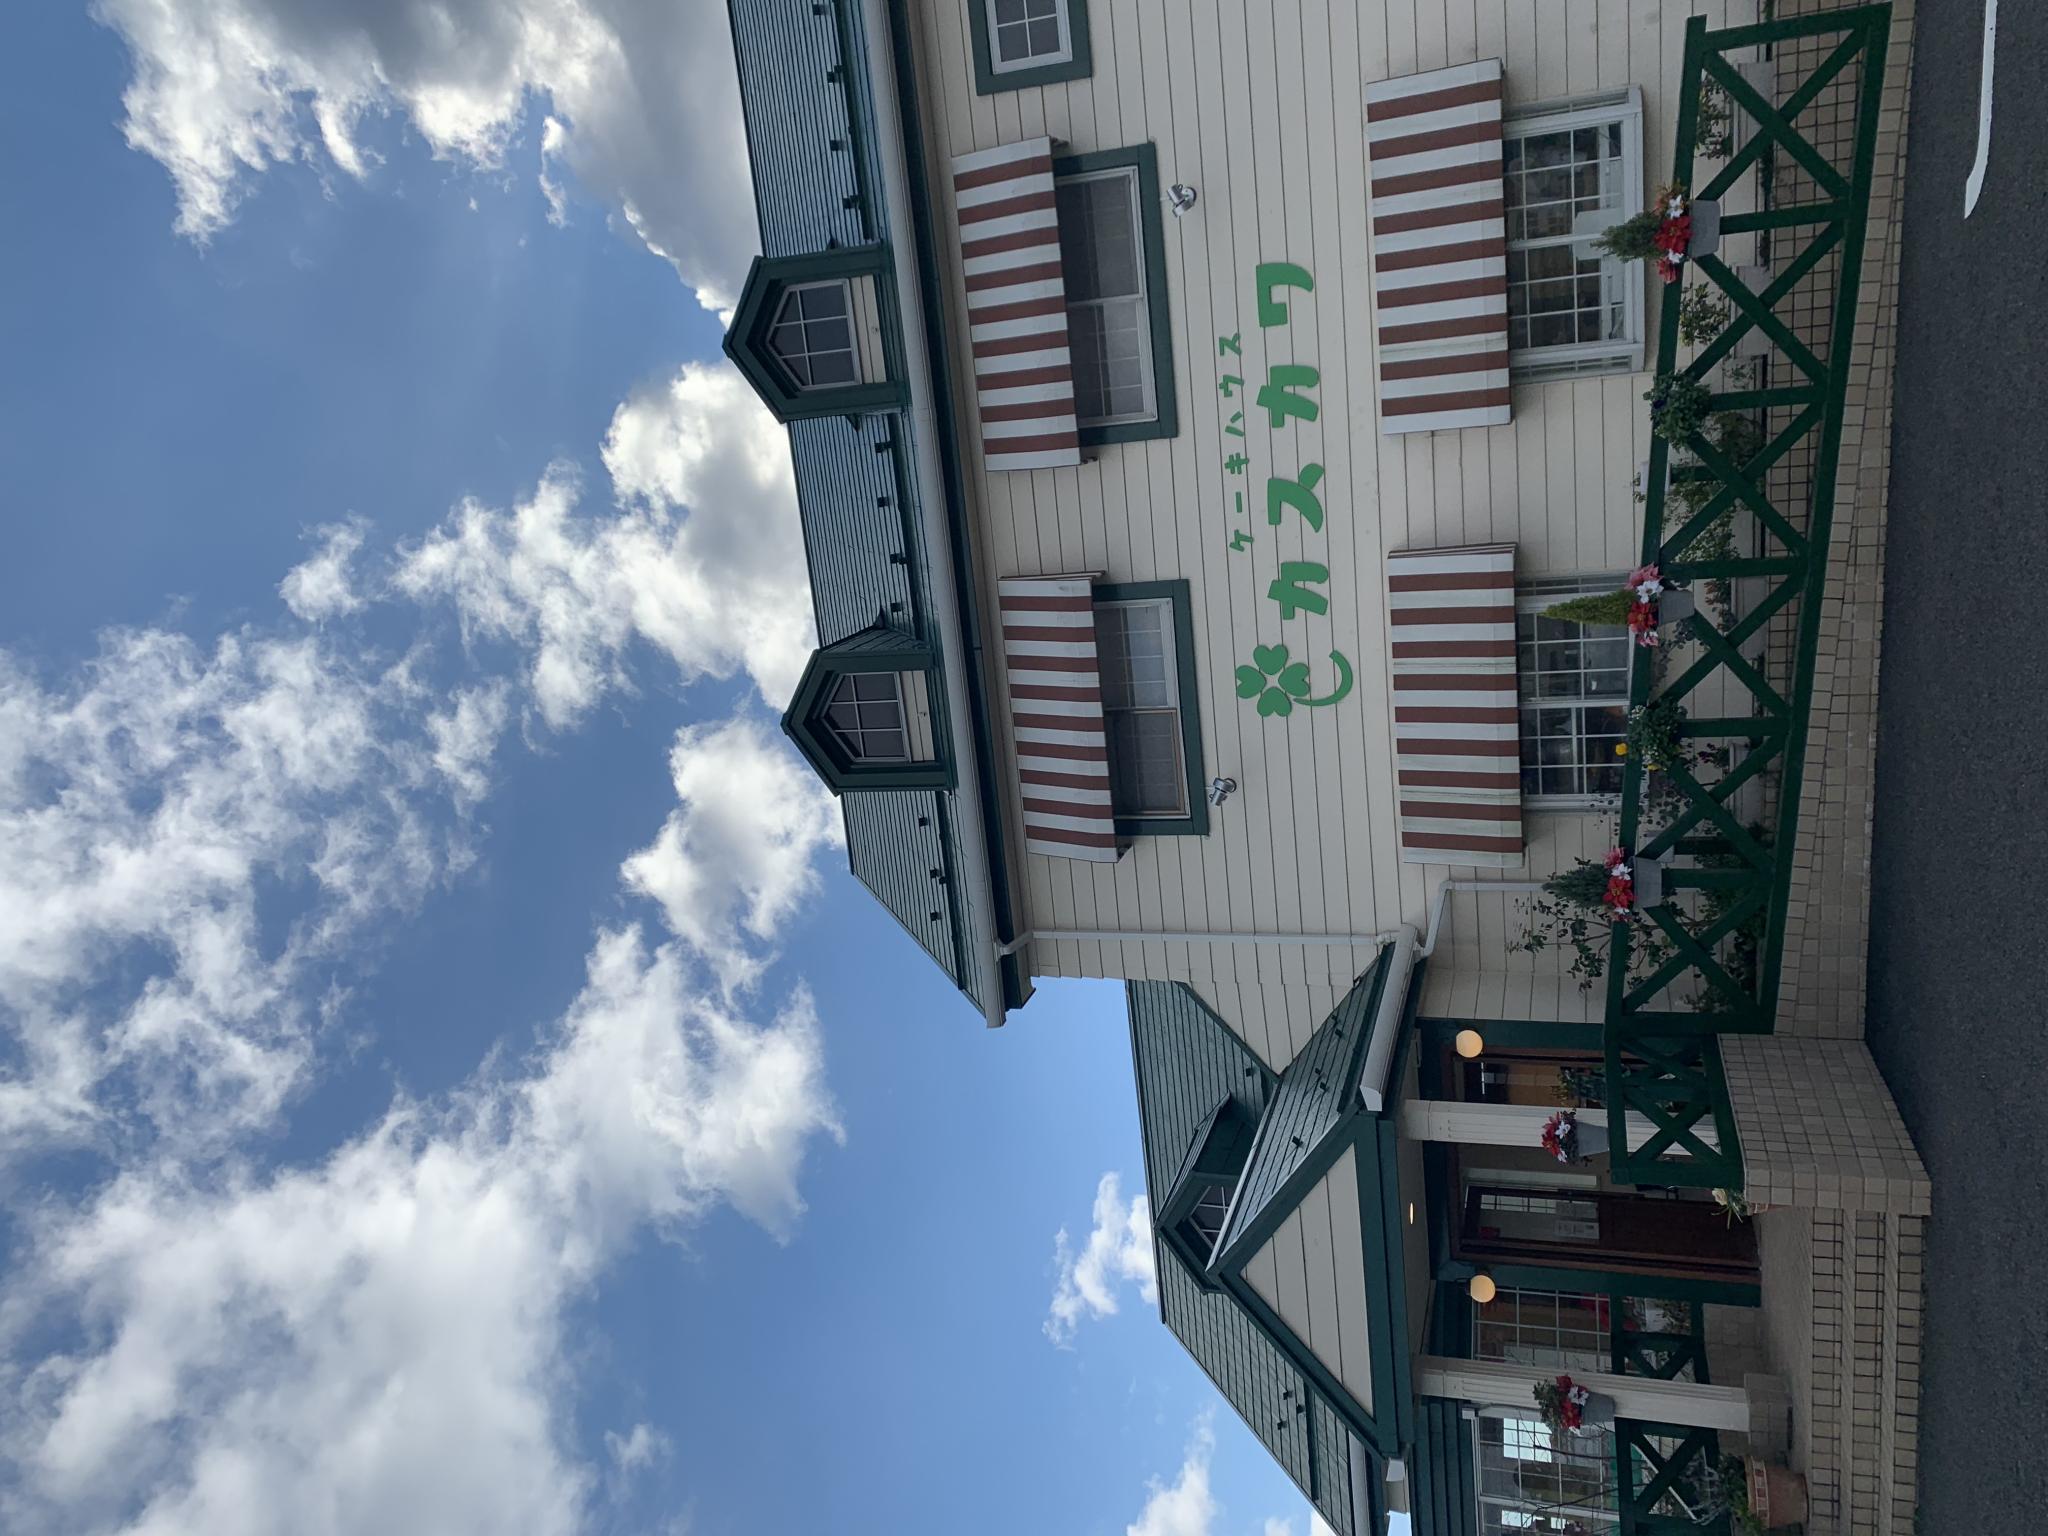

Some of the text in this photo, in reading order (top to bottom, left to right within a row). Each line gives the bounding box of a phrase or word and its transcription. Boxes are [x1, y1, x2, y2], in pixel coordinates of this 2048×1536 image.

[1219, 333, 1253, 552] ケーキハウス
[1256, 263, 1329, 620] カスカワ
